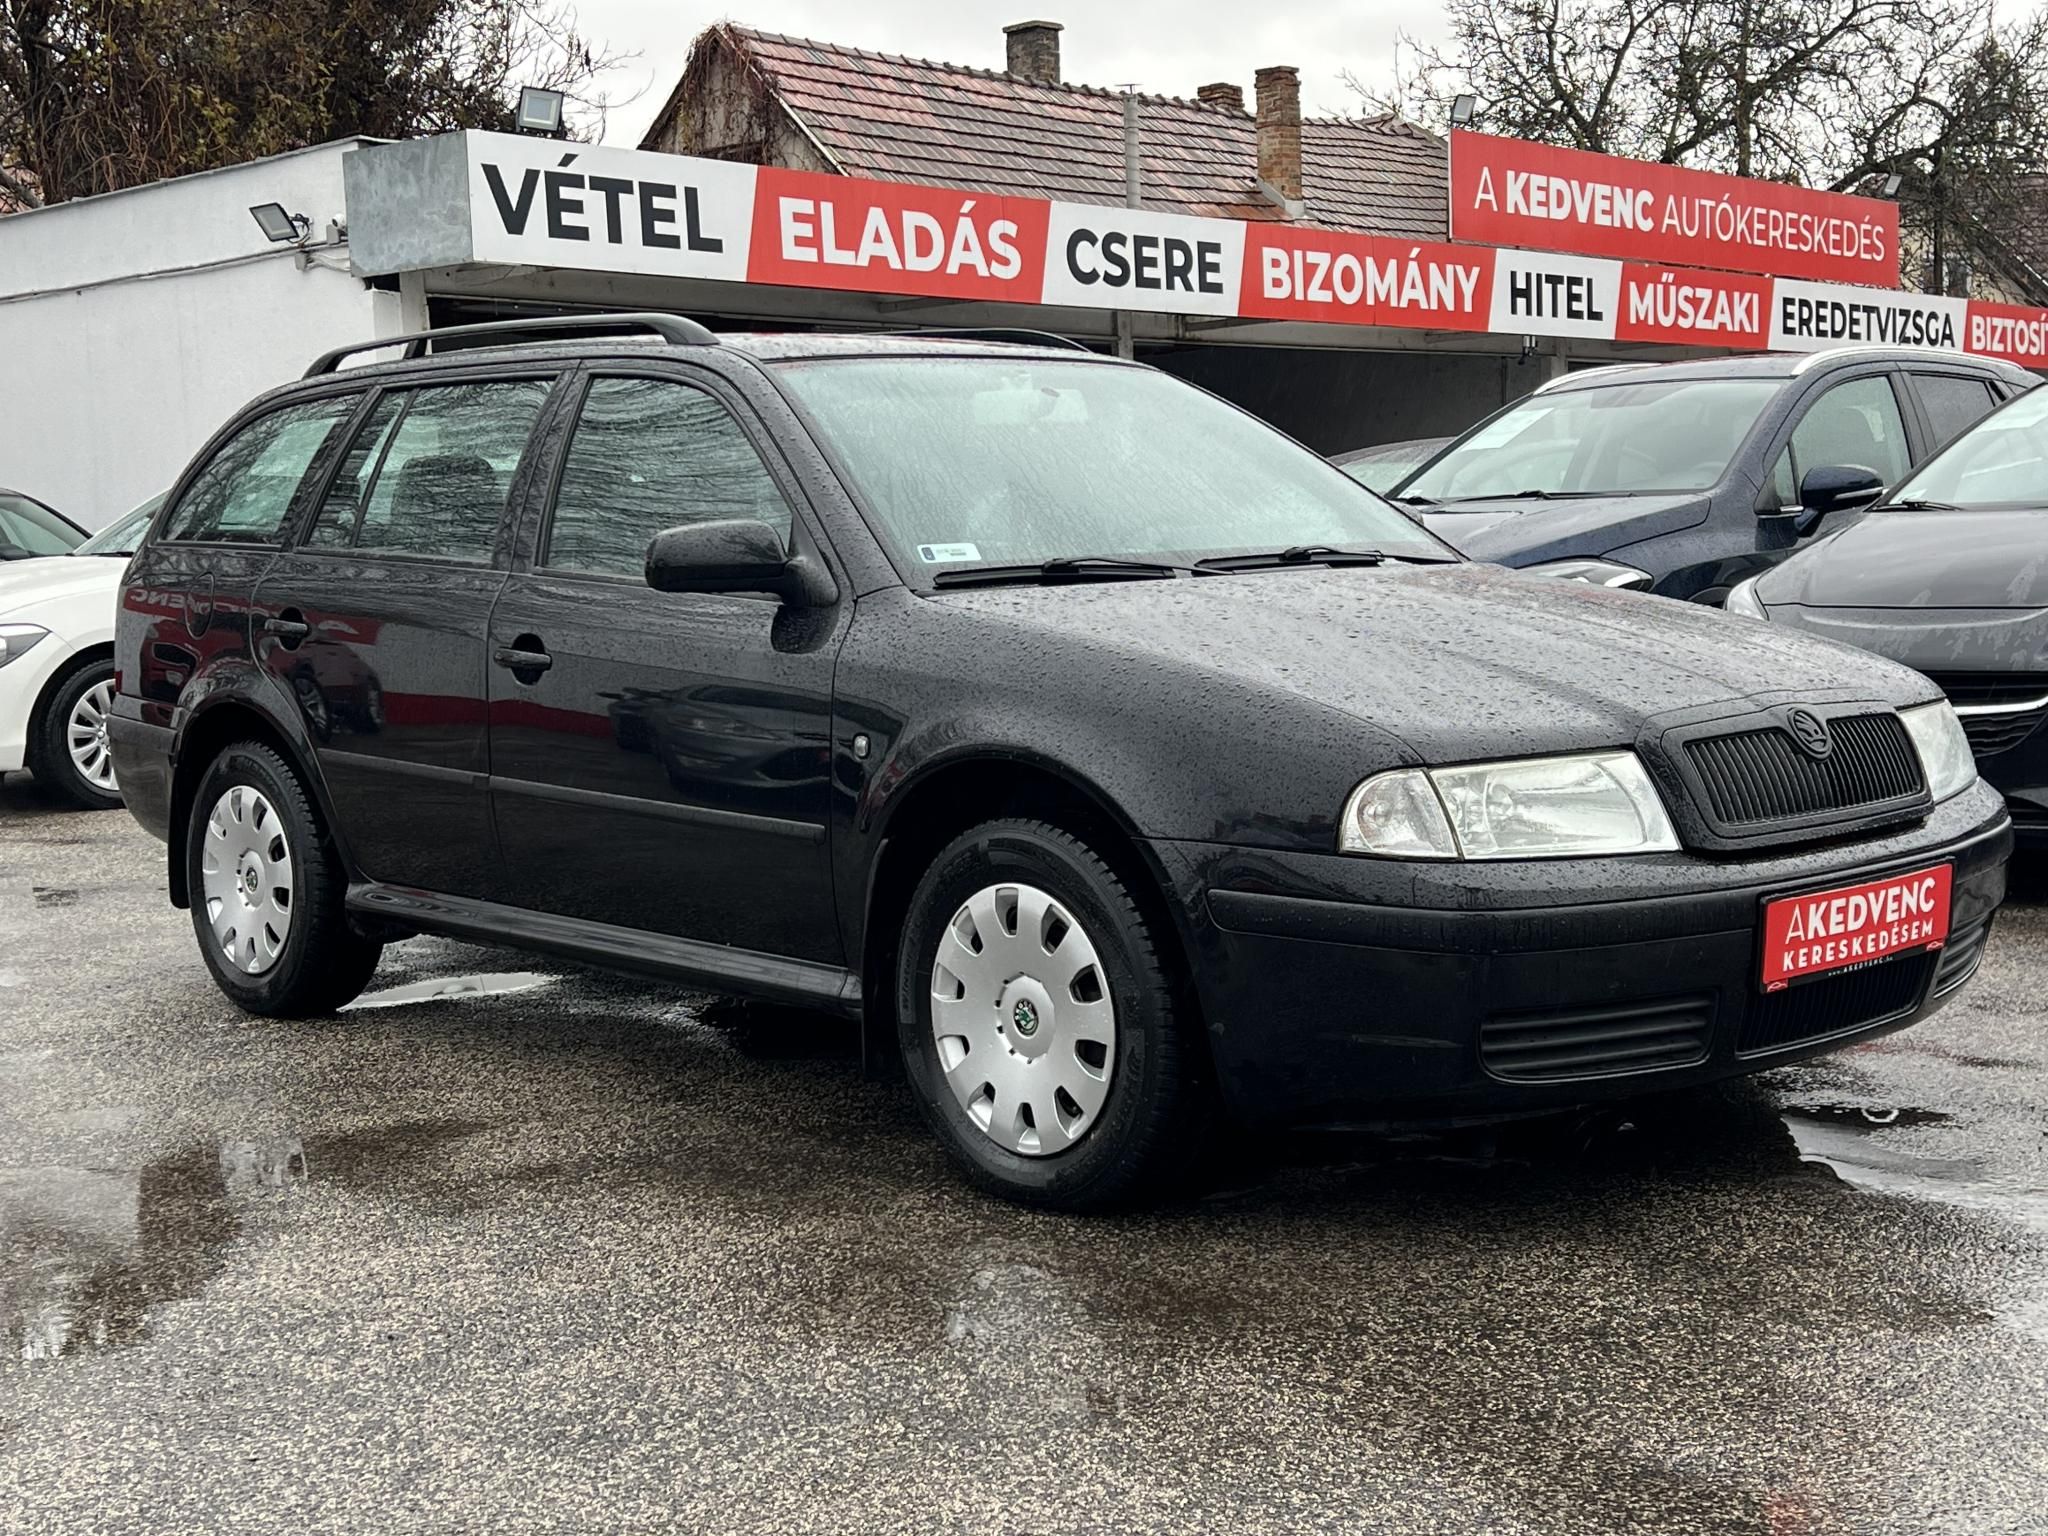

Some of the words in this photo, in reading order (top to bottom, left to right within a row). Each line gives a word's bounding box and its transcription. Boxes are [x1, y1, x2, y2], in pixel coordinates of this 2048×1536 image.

[481, 153, 723, 253] VÉTEL
[1474, 166, 1499, 212] A
[1506, 170, 1655, 232] KEDVENC
[1661, 194, 1886, 262] AUTÓKERESKEDÉS
[777, 196, 1022, 280] ELADÁS
[1066, 228, 1225, 295] CSERE
[1261, 247, 1481, 313] BIZOMÁNY
[1509, 270, 1604, 322] HITEL
[1628, 272, 1760, 334] MŰSZAKI
[1781, 296, 1956, 349] EREDETVIZSGA
[1972, 313, 2048, 356] BIZTOSÍ
[1783, 918, 1933, 972] KERESKEDÉSEM
